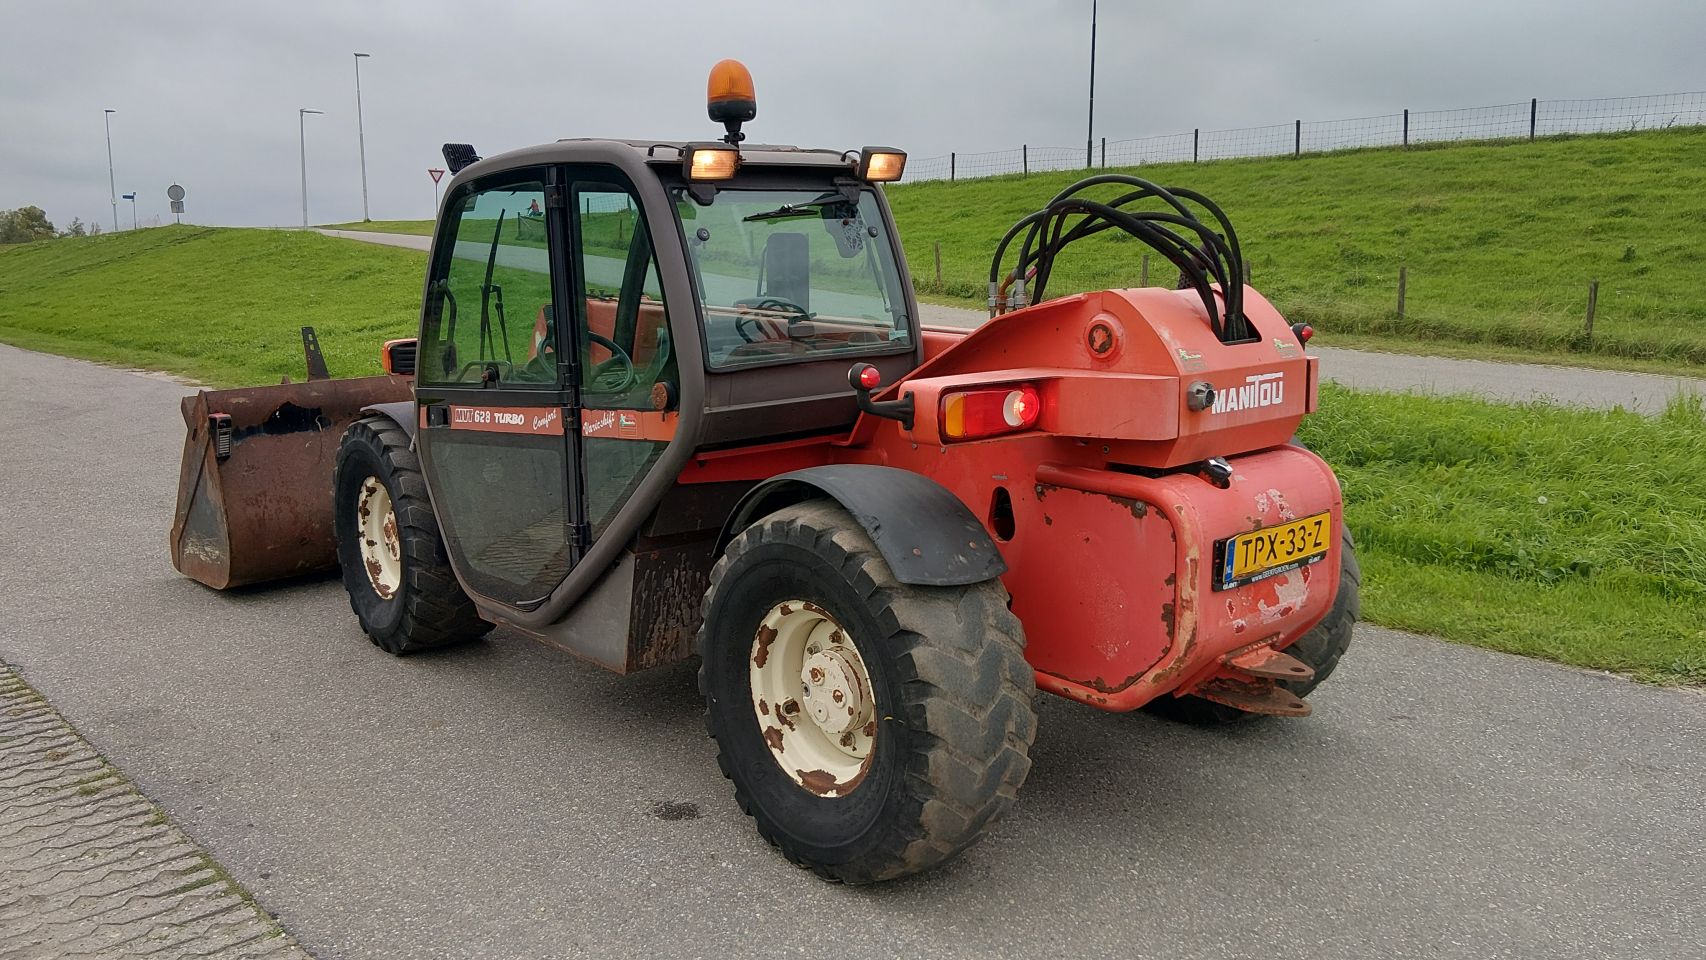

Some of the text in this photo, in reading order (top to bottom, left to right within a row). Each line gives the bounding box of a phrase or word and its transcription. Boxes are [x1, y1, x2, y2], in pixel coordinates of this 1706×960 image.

[1211, 372, 1284, 415] MANITOU
[455, 408, 557, 431] MVT 628 TURBO Comfort
[1242, 519, 1323, 568] TPX-33-Z
